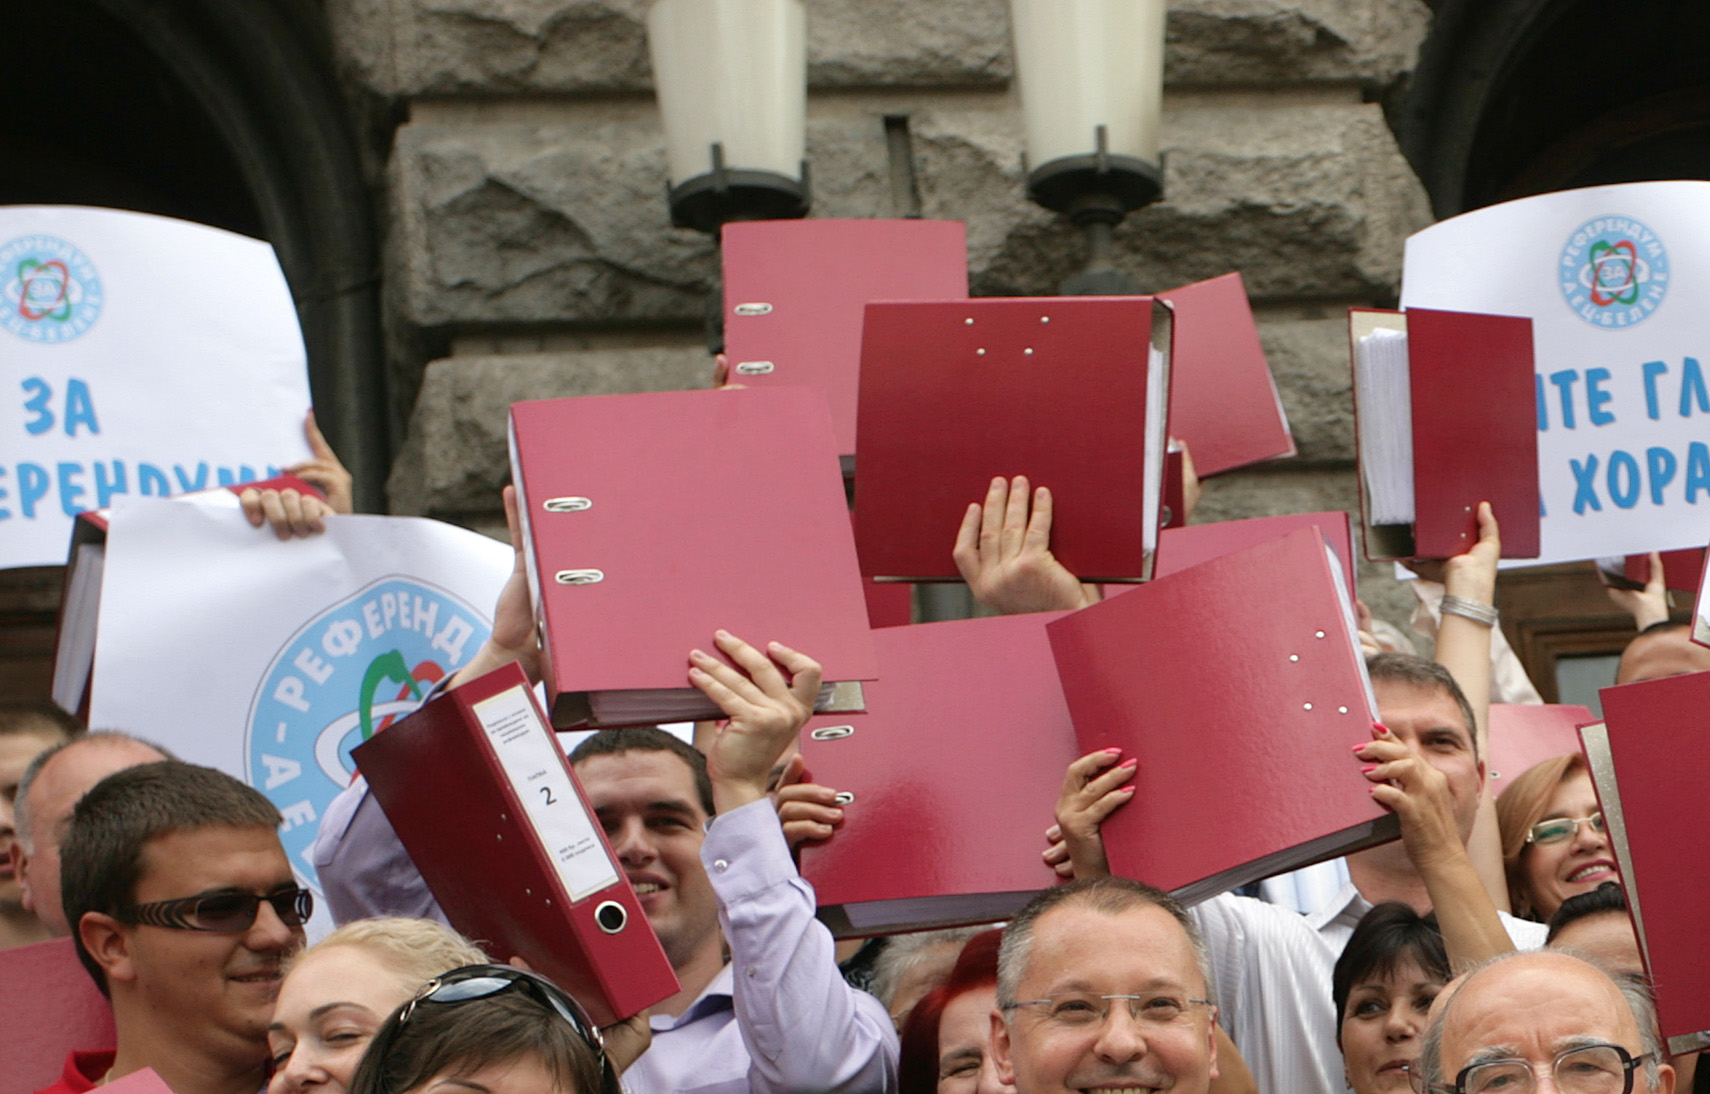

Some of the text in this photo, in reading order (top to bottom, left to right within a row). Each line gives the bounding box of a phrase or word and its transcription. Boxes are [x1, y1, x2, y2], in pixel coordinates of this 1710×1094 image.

[1602, 266, 1626, 281] ЗА
[21, 377, 100, 437] ЗА
[273, 590, 488, 713] РЕФЕРЕНД
[539, 786, 557, 805] 2
